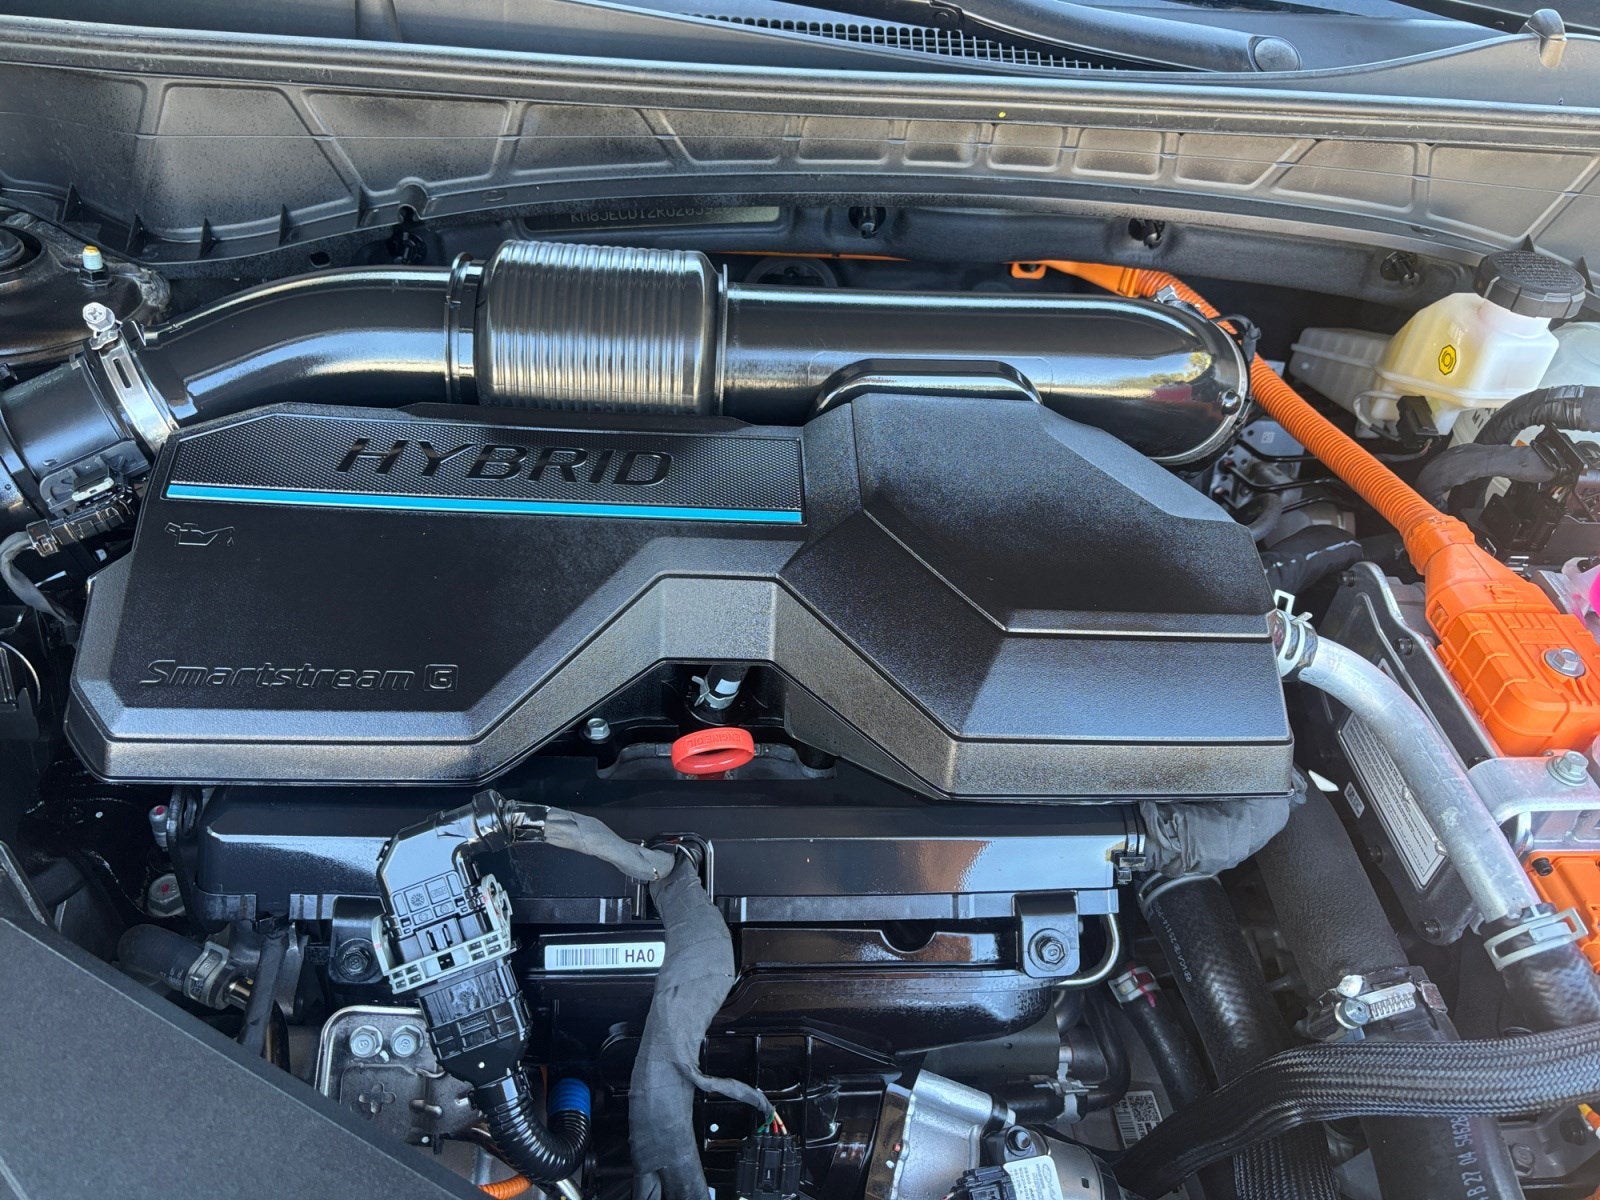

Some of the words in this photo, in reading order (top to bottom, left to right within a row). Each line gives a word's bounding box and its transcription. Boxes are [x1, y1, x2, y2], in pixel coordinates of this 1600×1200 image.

[336, 437, 673, 487] HYBRID
[139, 659, 415, 690] Smartstream
[426, 666, 456, 690] G
